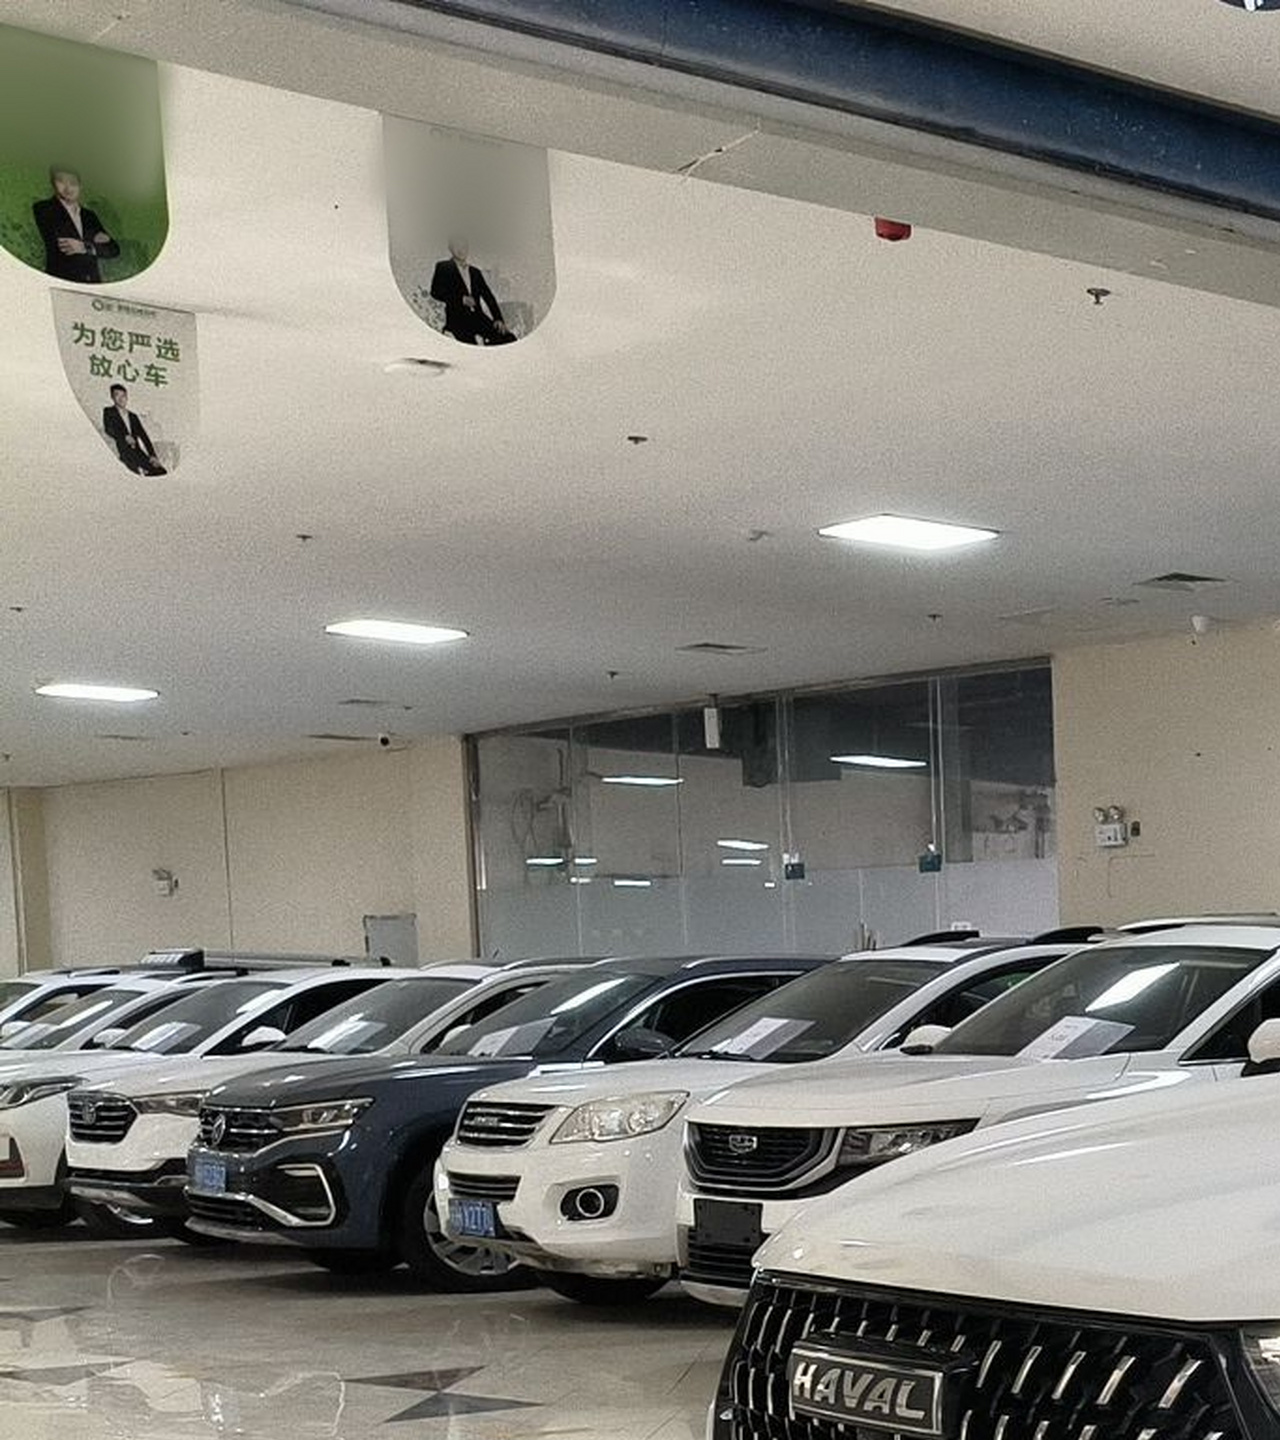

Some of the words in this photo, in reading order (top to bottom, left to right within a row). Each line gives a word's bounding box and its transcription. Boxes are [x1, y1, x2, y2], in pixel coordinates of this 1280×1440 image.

[72, 322, 180, 362] 为您严选
[89, 353, 168, 387] 放心车
[793, 1361, 925, 1420] HAVAL
